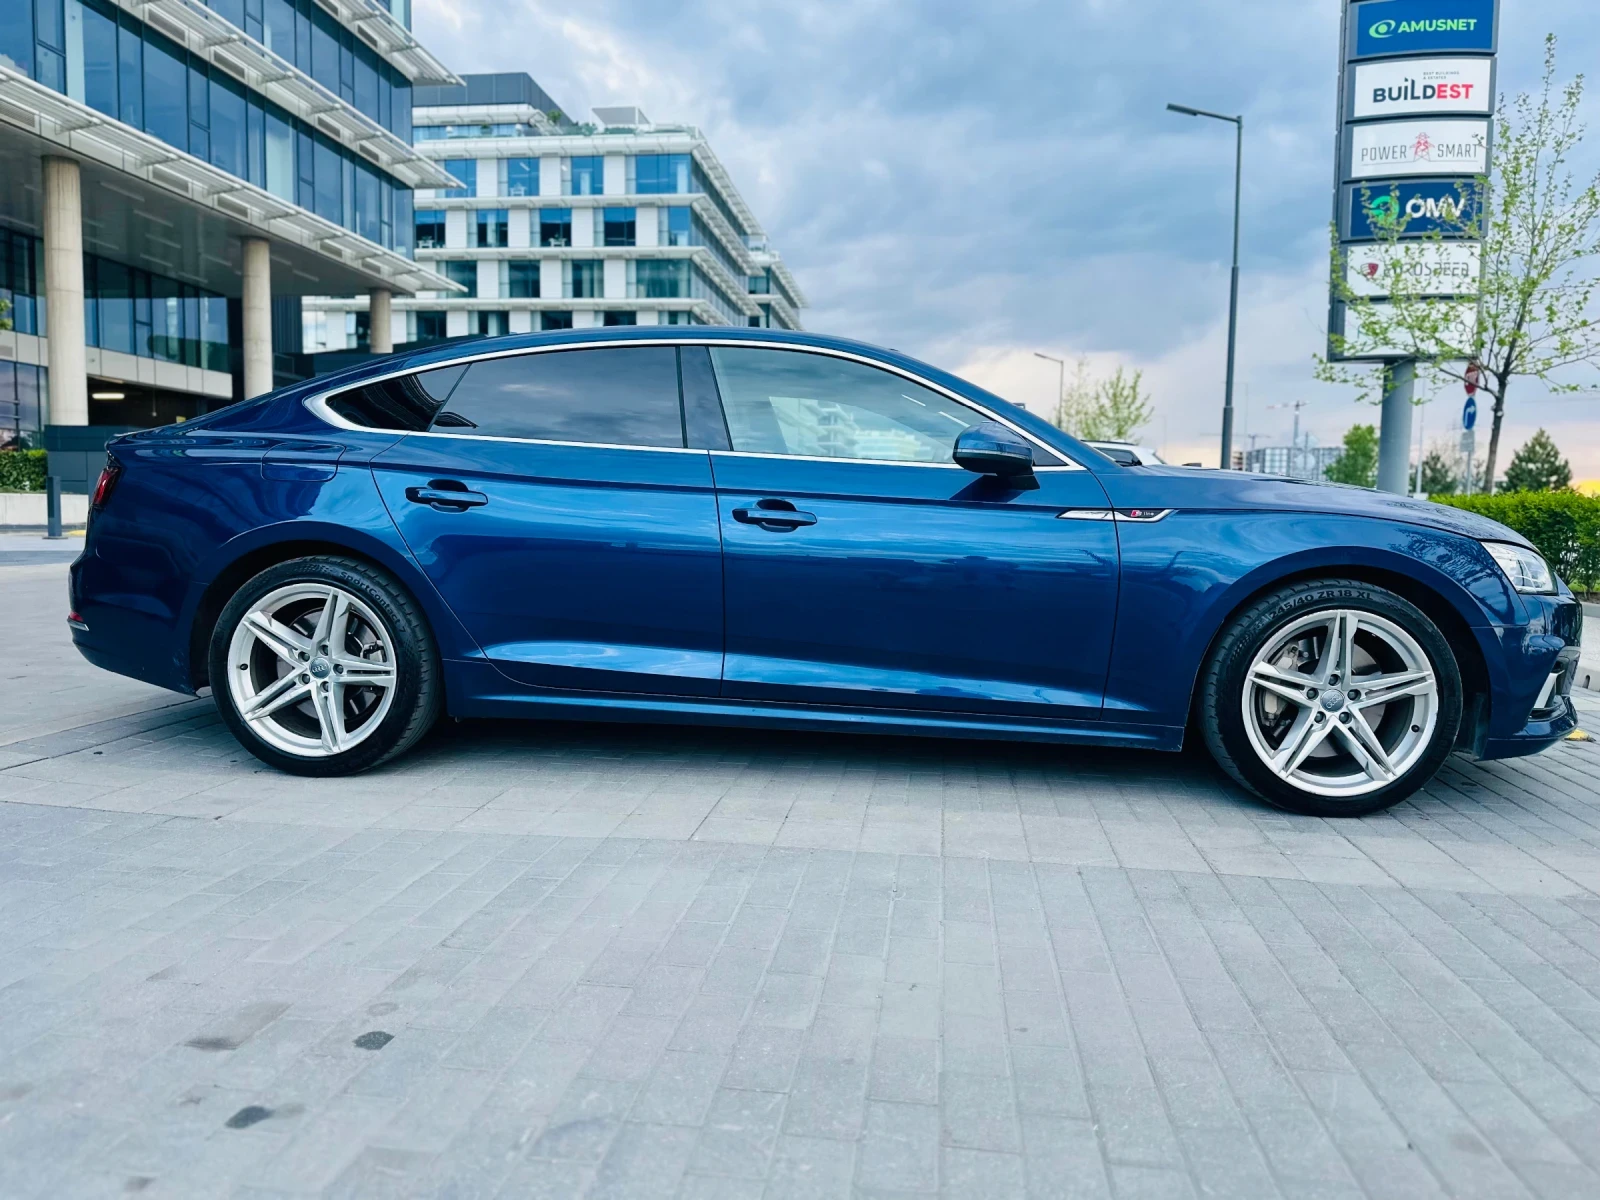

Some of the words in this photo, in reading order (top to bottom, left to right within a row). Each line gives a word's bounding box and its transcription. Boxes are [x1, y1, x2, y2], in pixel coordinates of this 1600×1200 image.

[1398, 19, 1477, 33] AMUSNET
[1361, 145, 1407, 162] POWER
[1437, 143, 1478, 158] SMART
[1405, 197, 1465, 219] OMV
[340, 570, 402, 624] SportContact
[1269, 594, 1315, 619] 245/40
[1316, 590, 1335, 599] ZR
[1339, 589, 1353, 598] 18
